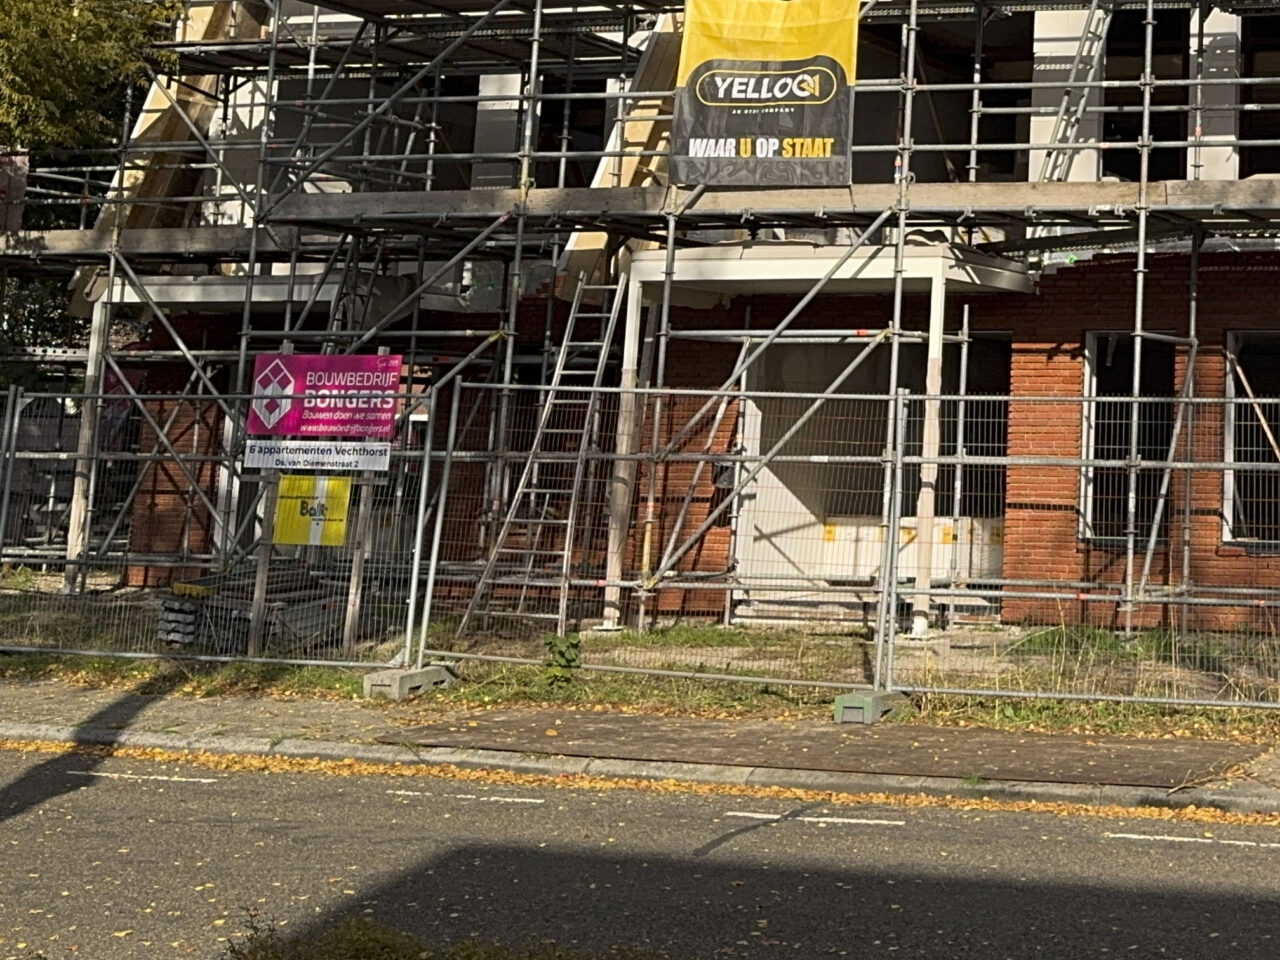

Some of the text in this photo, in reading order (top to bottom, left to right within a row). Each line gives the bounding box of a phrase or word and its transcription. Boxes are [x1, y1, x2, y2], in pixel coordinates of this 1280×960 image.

[688, 138, 834, 158] WAAR U OP STAAT
[306, 371, 398, 387] BOUWBEDRIJF
[304, 389, 395, 408] BONGERS
[302, 410, 333, 420] Bouwen
[333, 410, 352, 420] doen
[249, 445, 388, 456] 6 appartementen Vechthorst
[303, 459, 353, 467] Diemenstraat
